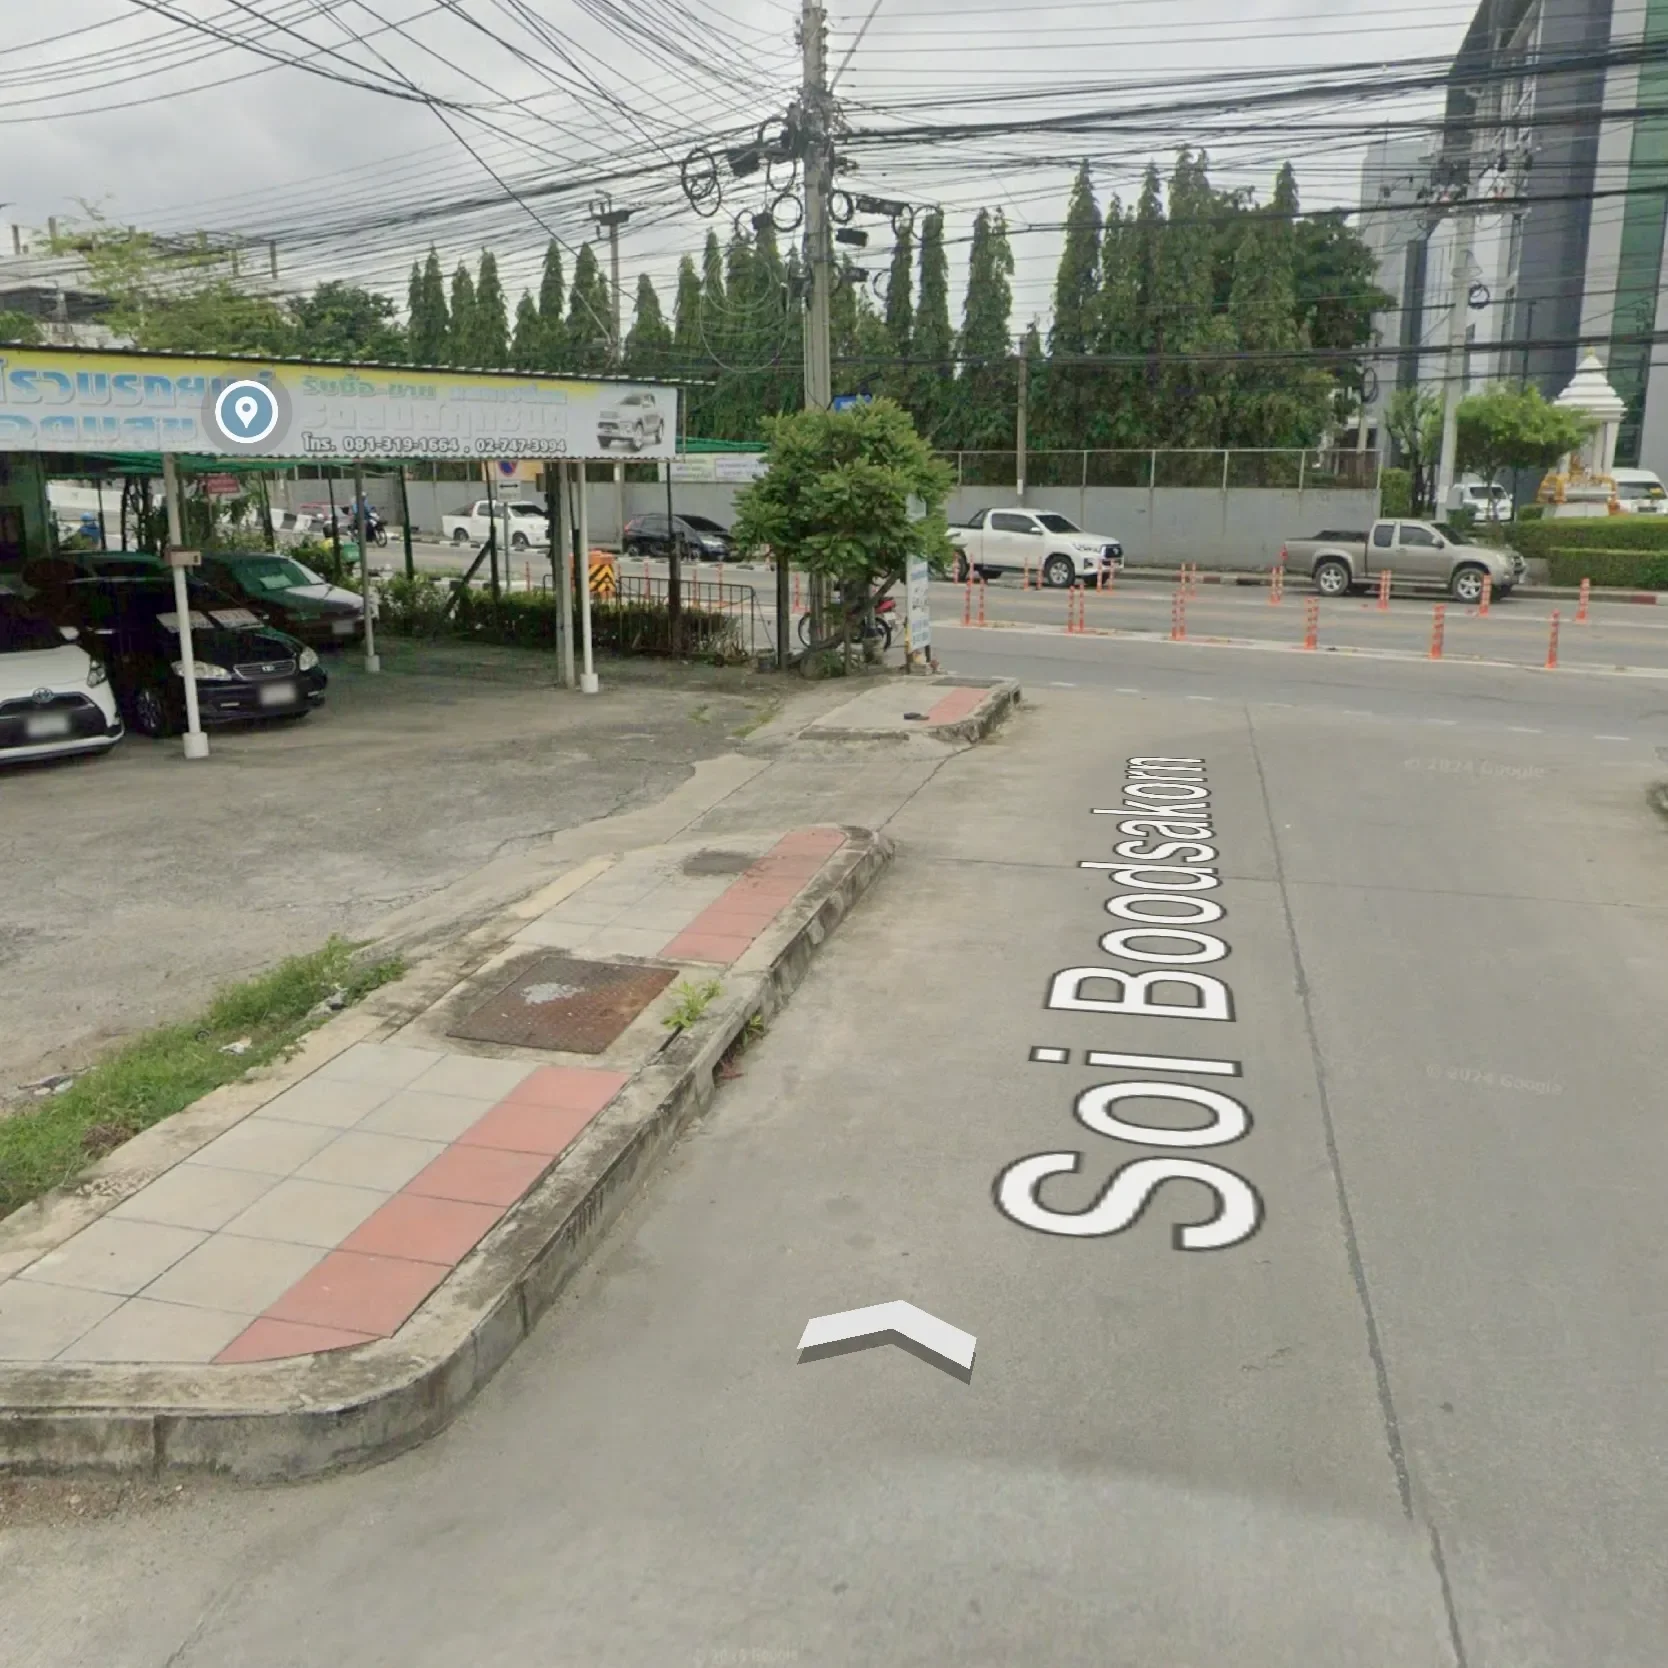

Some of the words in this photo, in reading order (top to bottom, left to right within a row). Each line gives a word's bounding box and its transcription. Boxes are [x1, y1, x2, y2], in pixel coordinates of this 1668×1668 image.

[301, 432, 337, 453] โทร.
[342, 435, 460, 454] 081-319-1664
[475, 437, 567, 454] 02-747-3994
